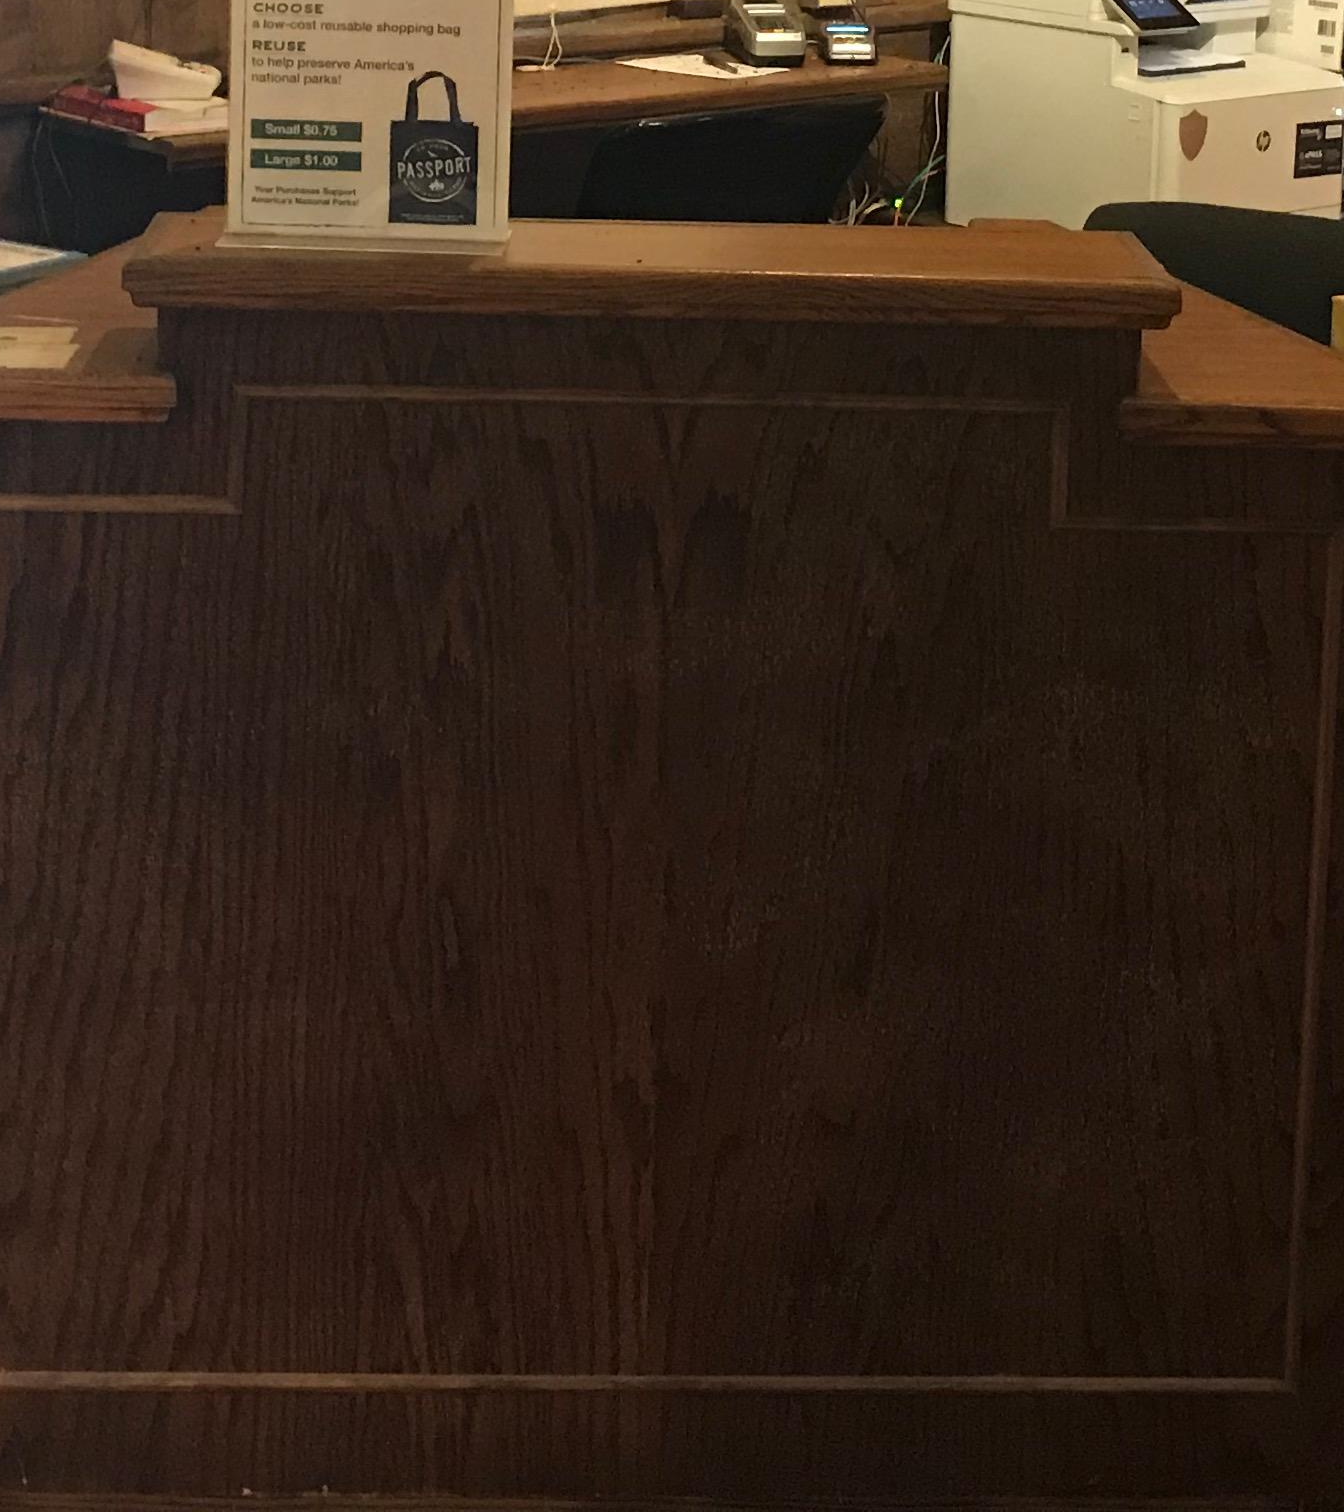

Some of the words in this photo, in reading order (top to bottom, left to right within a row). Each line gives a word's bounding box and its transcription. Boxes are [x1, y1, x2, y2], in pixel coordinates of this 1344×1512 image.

[253, 3, 324, 14] CHOOSE
[252, 21, 260, 29] a
[263, 19, 316, 30] low-cost
[321, 20, 372, 32] reusable
[377, 22, 433, 36] shopping
[437, 23, 461, 36] bag
[252, 40, 306, 52] REUSE
[252, 56, 264, 67] to
[267, 56, 294, 70] help
[297, 59, 350, 70] preserve
[354, 59, 414, 71] America's
[251, 73, 300, 83] national
[304, 73, 341, 85] parks!
[265, 123, 300, 135] Small
[304, 125, 337, 136] $0.75
[265, 153, 300, 167] Large
[304, 154, 338, 166] $1.00
[397, 156, 471, 179] PASSPORT
